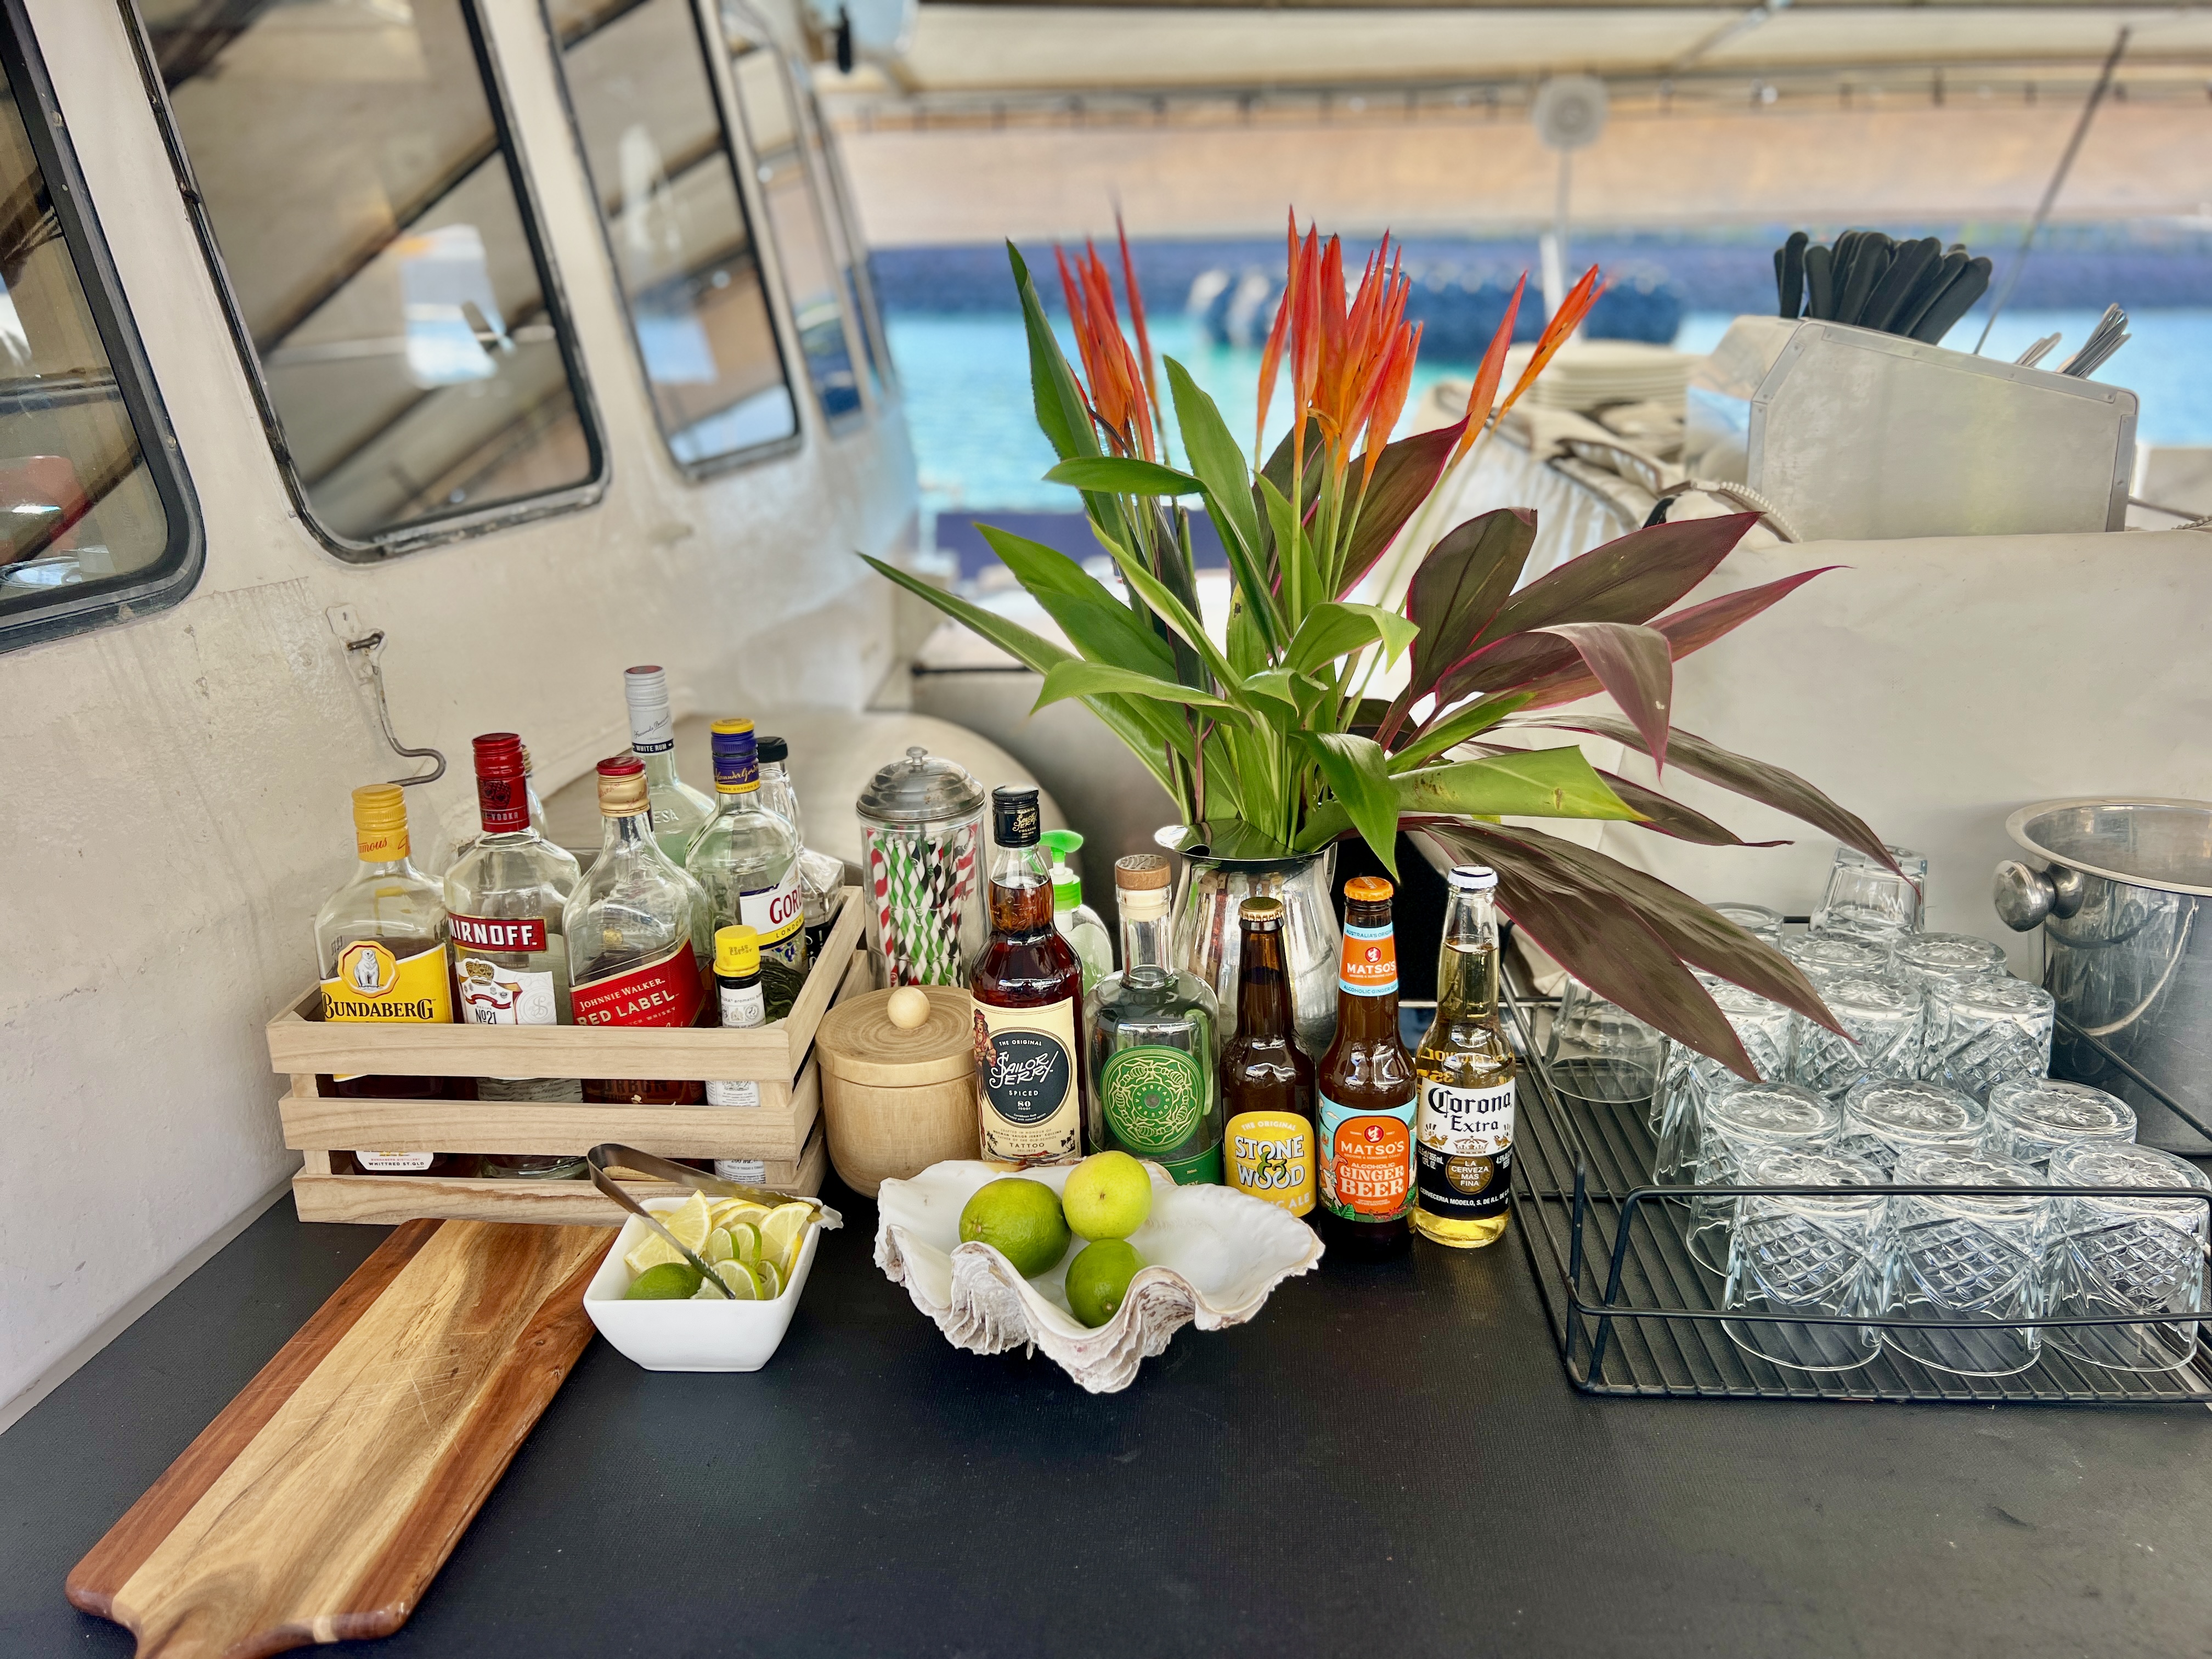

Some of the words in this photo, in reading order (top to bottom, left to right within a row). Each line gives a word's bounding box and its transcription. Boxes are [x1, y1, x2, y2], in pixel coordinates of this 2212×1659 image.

[655, 743, 667, 751] RUM
[492, 811, 518, 821] VODKA
[653, 809, 679, 824] ESA
[448, 917, 533, 945] MIRNOFF
[776, 918, 802, 939] LONDON
[1346, 929, 1377, 938] AUSTRALIA'S
[1347, 960, 1396, 974] MATSO'S
[579, 991, 622, 1012] JOHNNIE
[620, 978, 662, 996] WALKER
[1344, 985, 1372, 994] ALCOHOLIC
[321, 991, 434, 1020] BUNDABERG
[576, 1010, 612, 1026] RED
[615, 989, 676, 1018] LABEL
[646, 1006, 676, 1021] WHISKY
[991, 1051, 1049, 1079] SAILOR
[1427, 1087, 1511, 1119] Corona
[1241, 1122, 1255, 1131] THE
[1257, 1120, 1296, 1131] ORIGINAL
[1450, 1114, 1499, 1132] Extra
[1234, 1134, 1305, 1160] STONE
[1340, 1140, 1405, 1155] MATSO'S
[1236, 1161, 1305, 1190] WOOD
[1257, 1151, 1288, 1181] &
[1340, 1165, 1405, 1182] GINGER
[1340, 1177, 1404, 1198] BEER
[1420, 1187, 1449, 1204] CERVECERIA
[1449, 1198, 1476, 1207] MODELO,
[1289, 1192, 1311, 1209] ALE
